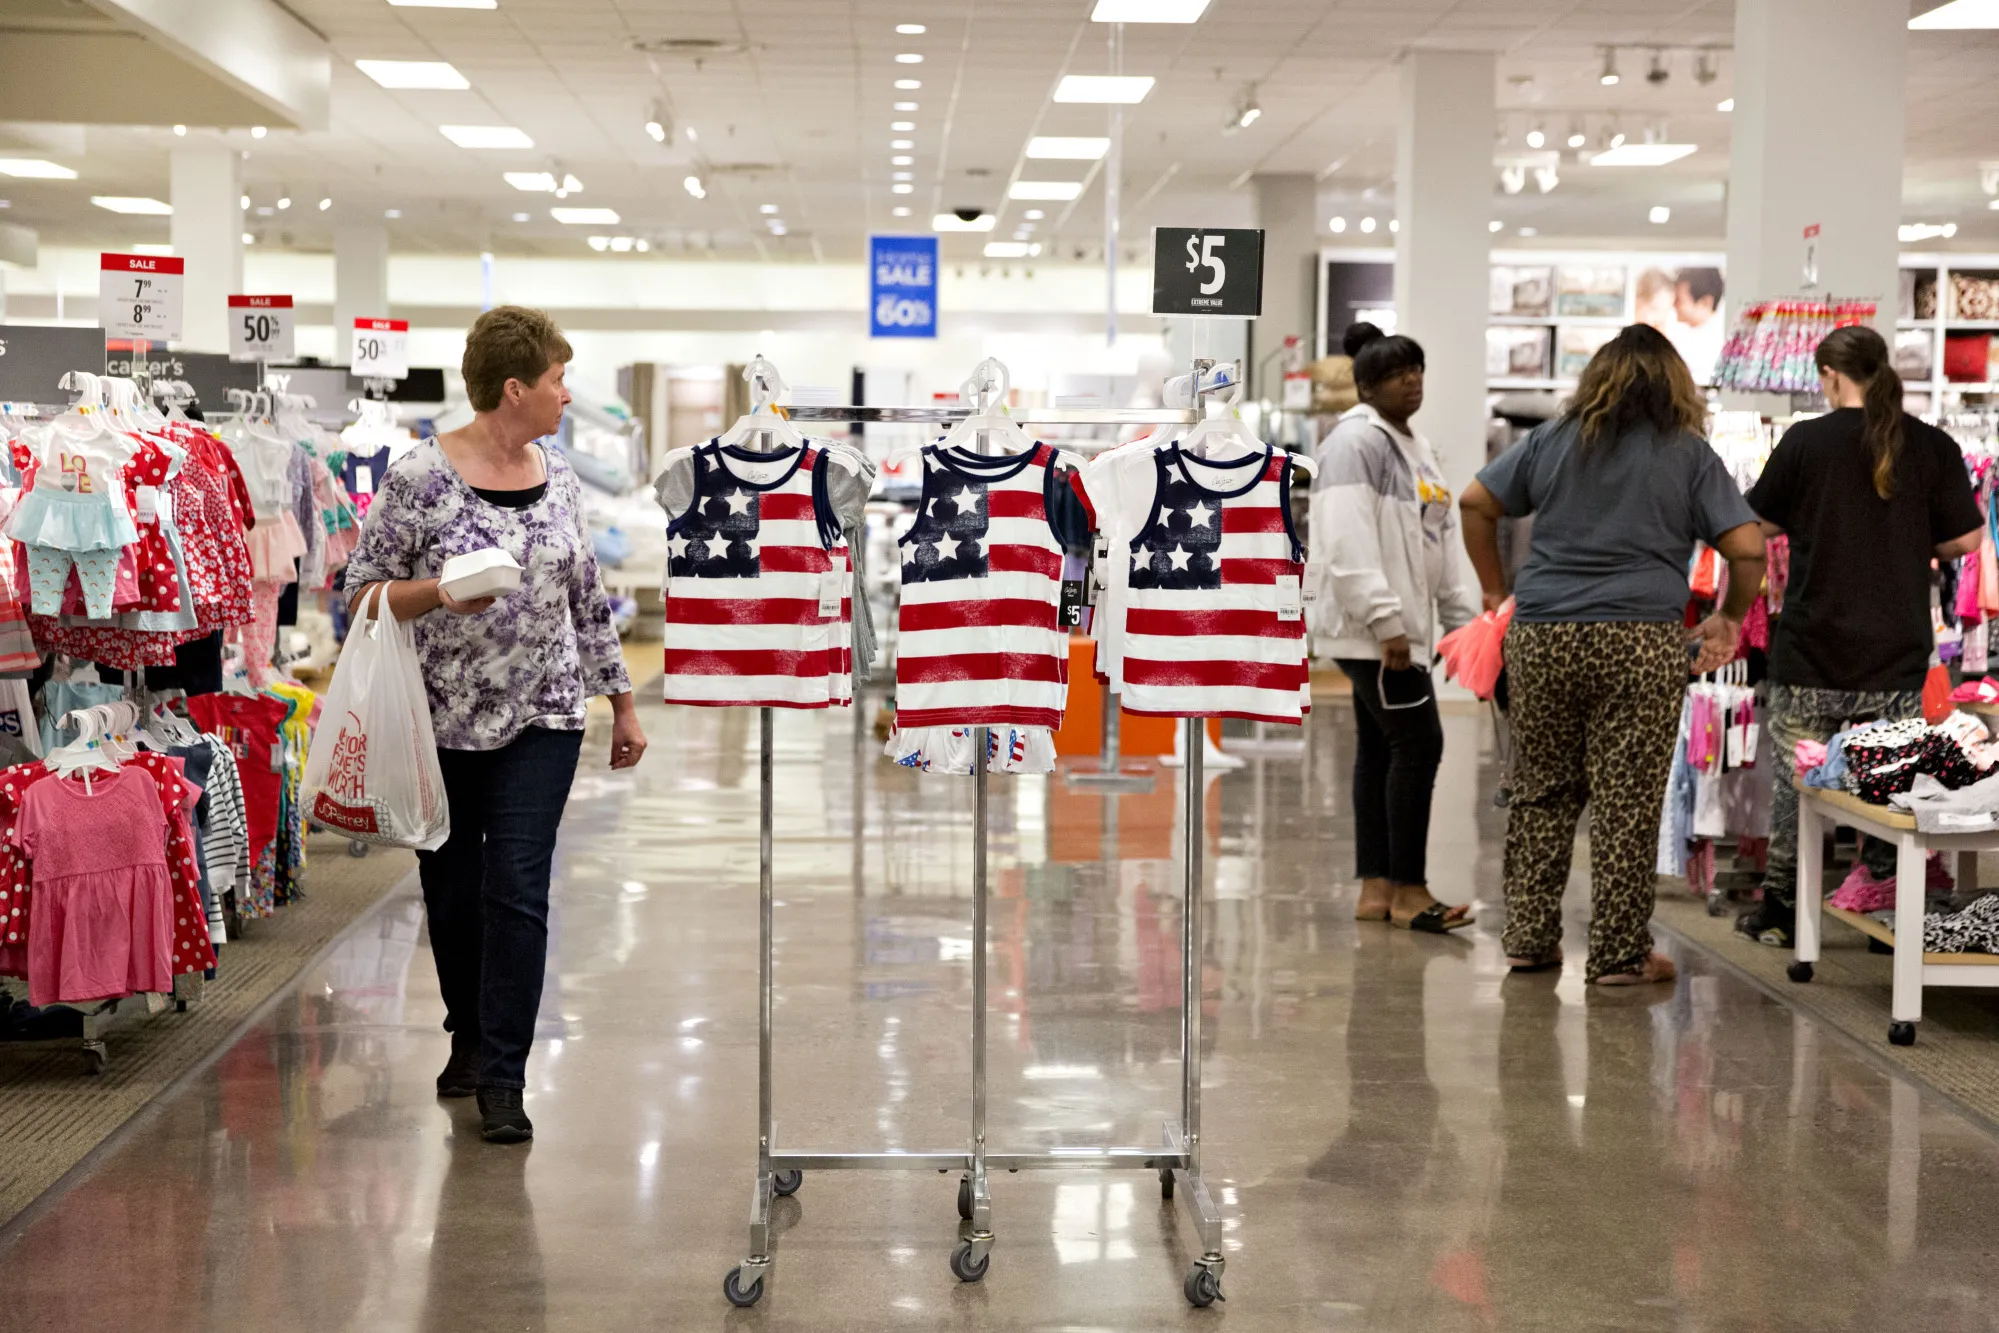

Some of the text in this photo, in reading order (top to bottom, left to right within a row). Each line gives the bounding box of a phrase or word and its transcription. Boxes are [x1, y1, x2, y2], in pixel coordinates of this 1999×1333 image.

[129, 259, 156, 270] SALE
[1185, 234, 1226, 295] $5
[876, 264, 932, 286] SALE
[250, 297, 271, 306] SALE
[1190, 298, 1223, 307] EXTREME VALUE
[108, 357, 184, 376] caer's
[1067, 605, 1080, 625] $5
